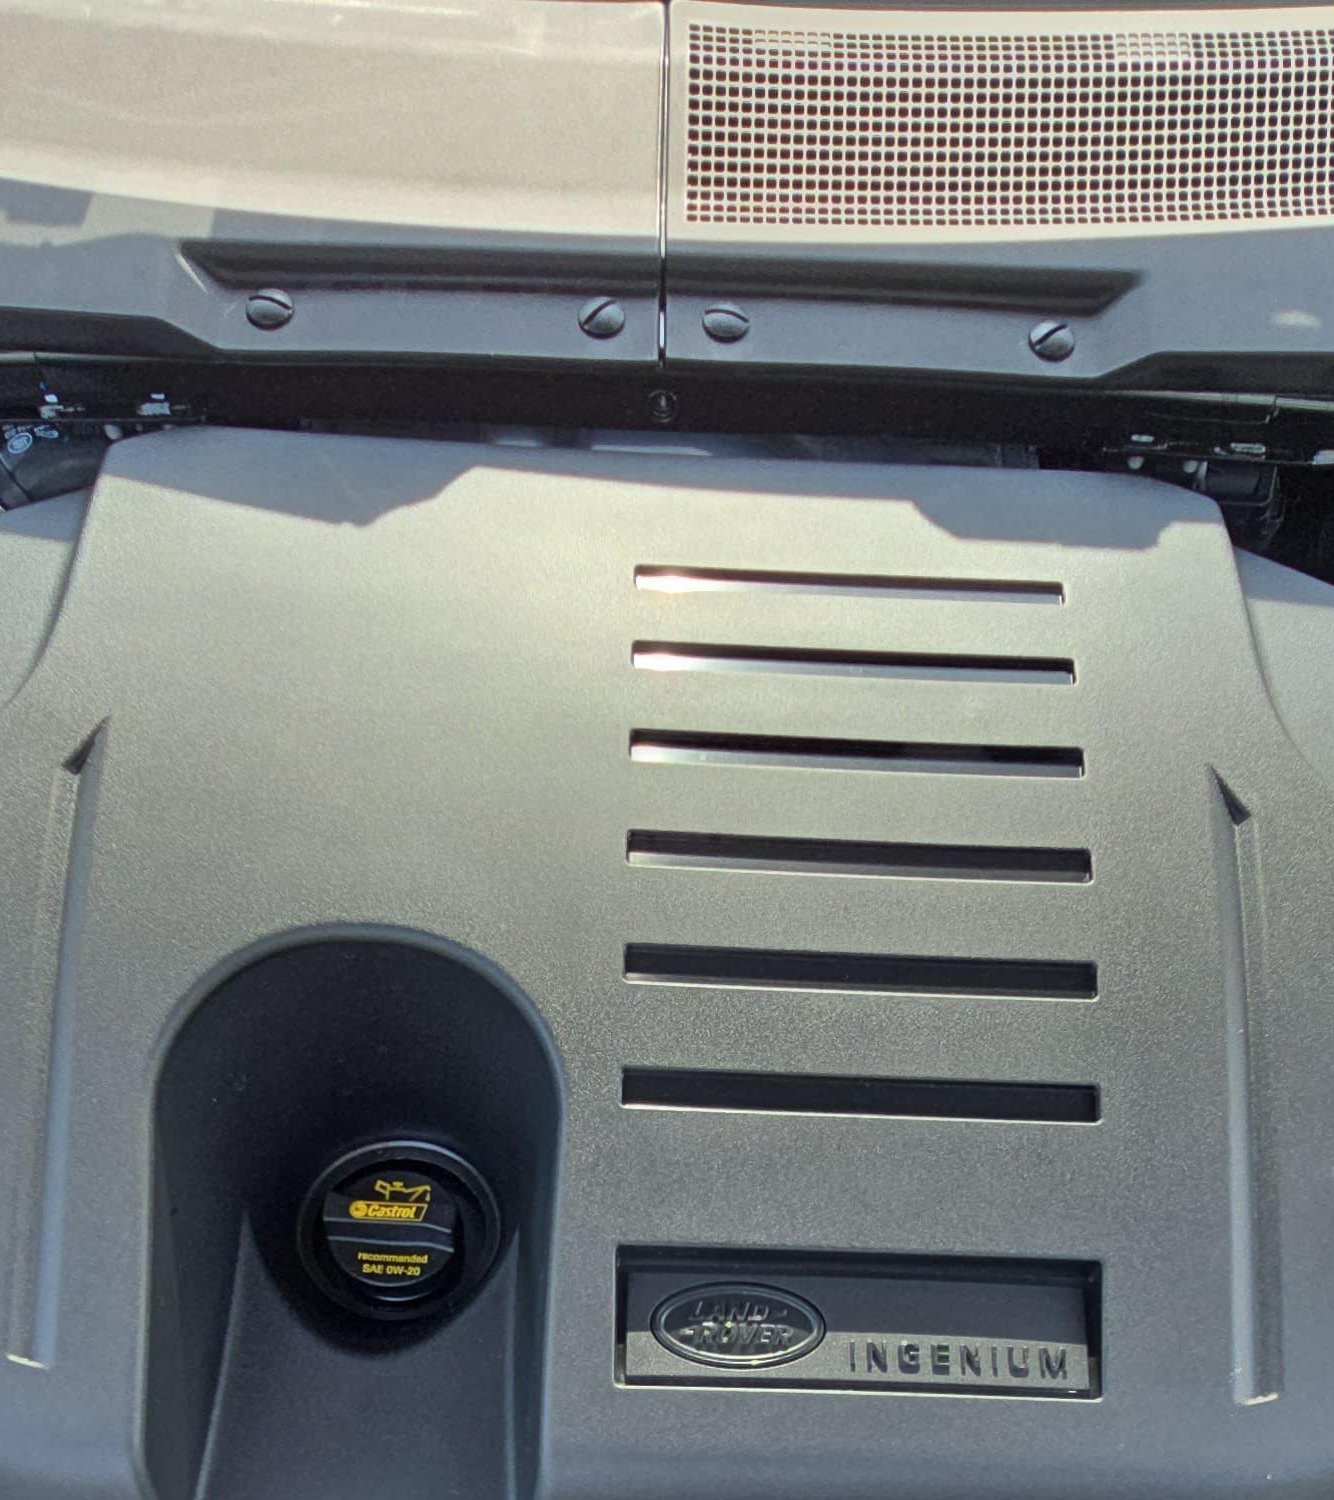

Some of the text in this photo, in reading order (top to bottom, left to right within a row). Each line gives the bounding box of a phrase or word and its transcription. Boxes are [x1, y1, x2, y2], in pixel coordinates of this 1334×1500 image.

[367, 1205, 416, 1218] Castrol
[358, 1252, 428, 1264] recommended
[362, 1264, 420, 1275] SAE 0W-20
[696, 1322, 795, 1346] ROVER
[848, 1338, 1069, 1381] INGENIUM
